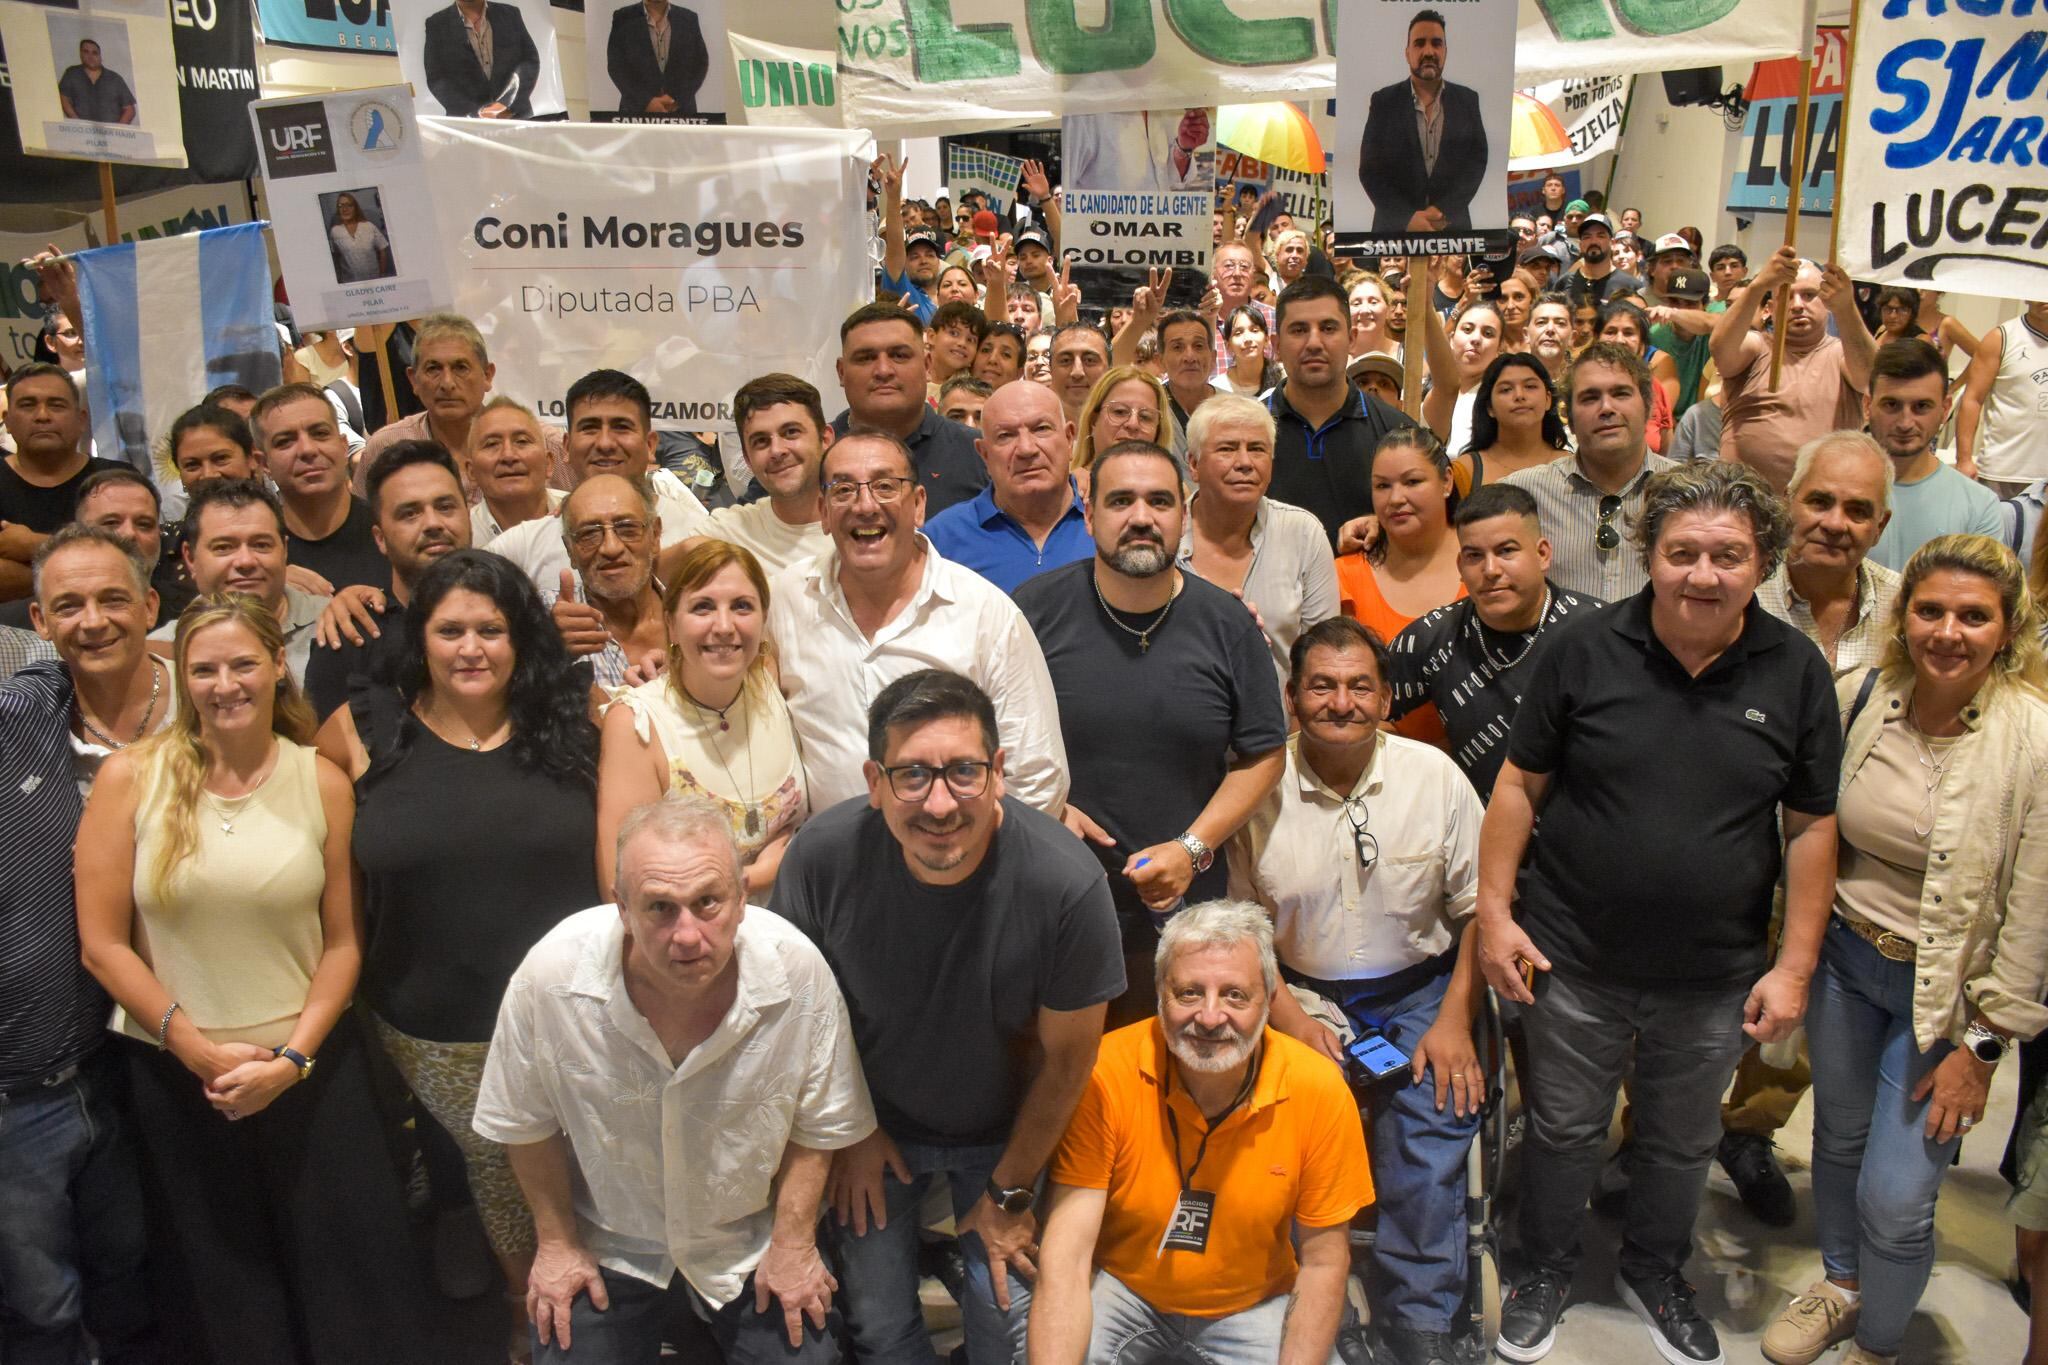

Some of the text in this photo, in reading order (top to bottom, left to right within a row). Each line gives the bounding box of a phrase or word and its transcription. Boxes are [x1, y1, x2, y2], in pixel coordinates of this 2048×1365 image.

[191, 66, 255, 90] MARTIN
[1564, 92, 1588, 112] POR
[1592, 74, 1623, 103] TODOS
[269, 123, 322, 151] URF
[1568, 97, 1624, 157] EZEIZA
[1947, 115, 2048, 167] AR
[1065, 194, 1207, 216] EL CANDIDATO DE LA GENTE
[473, 212, 805, 256] Coni Moragues
[1089, 220, 1184, 238] OMAR
[1062, 248, 1205, 266] COLOMBI
[1362, 237, 1486, 256] SAN VICENTE
[345, 286, 375, 297] GLADYS
[362, 298, 385, 307] PILAR
[521, 285, 761, 319] Diputada PBA
